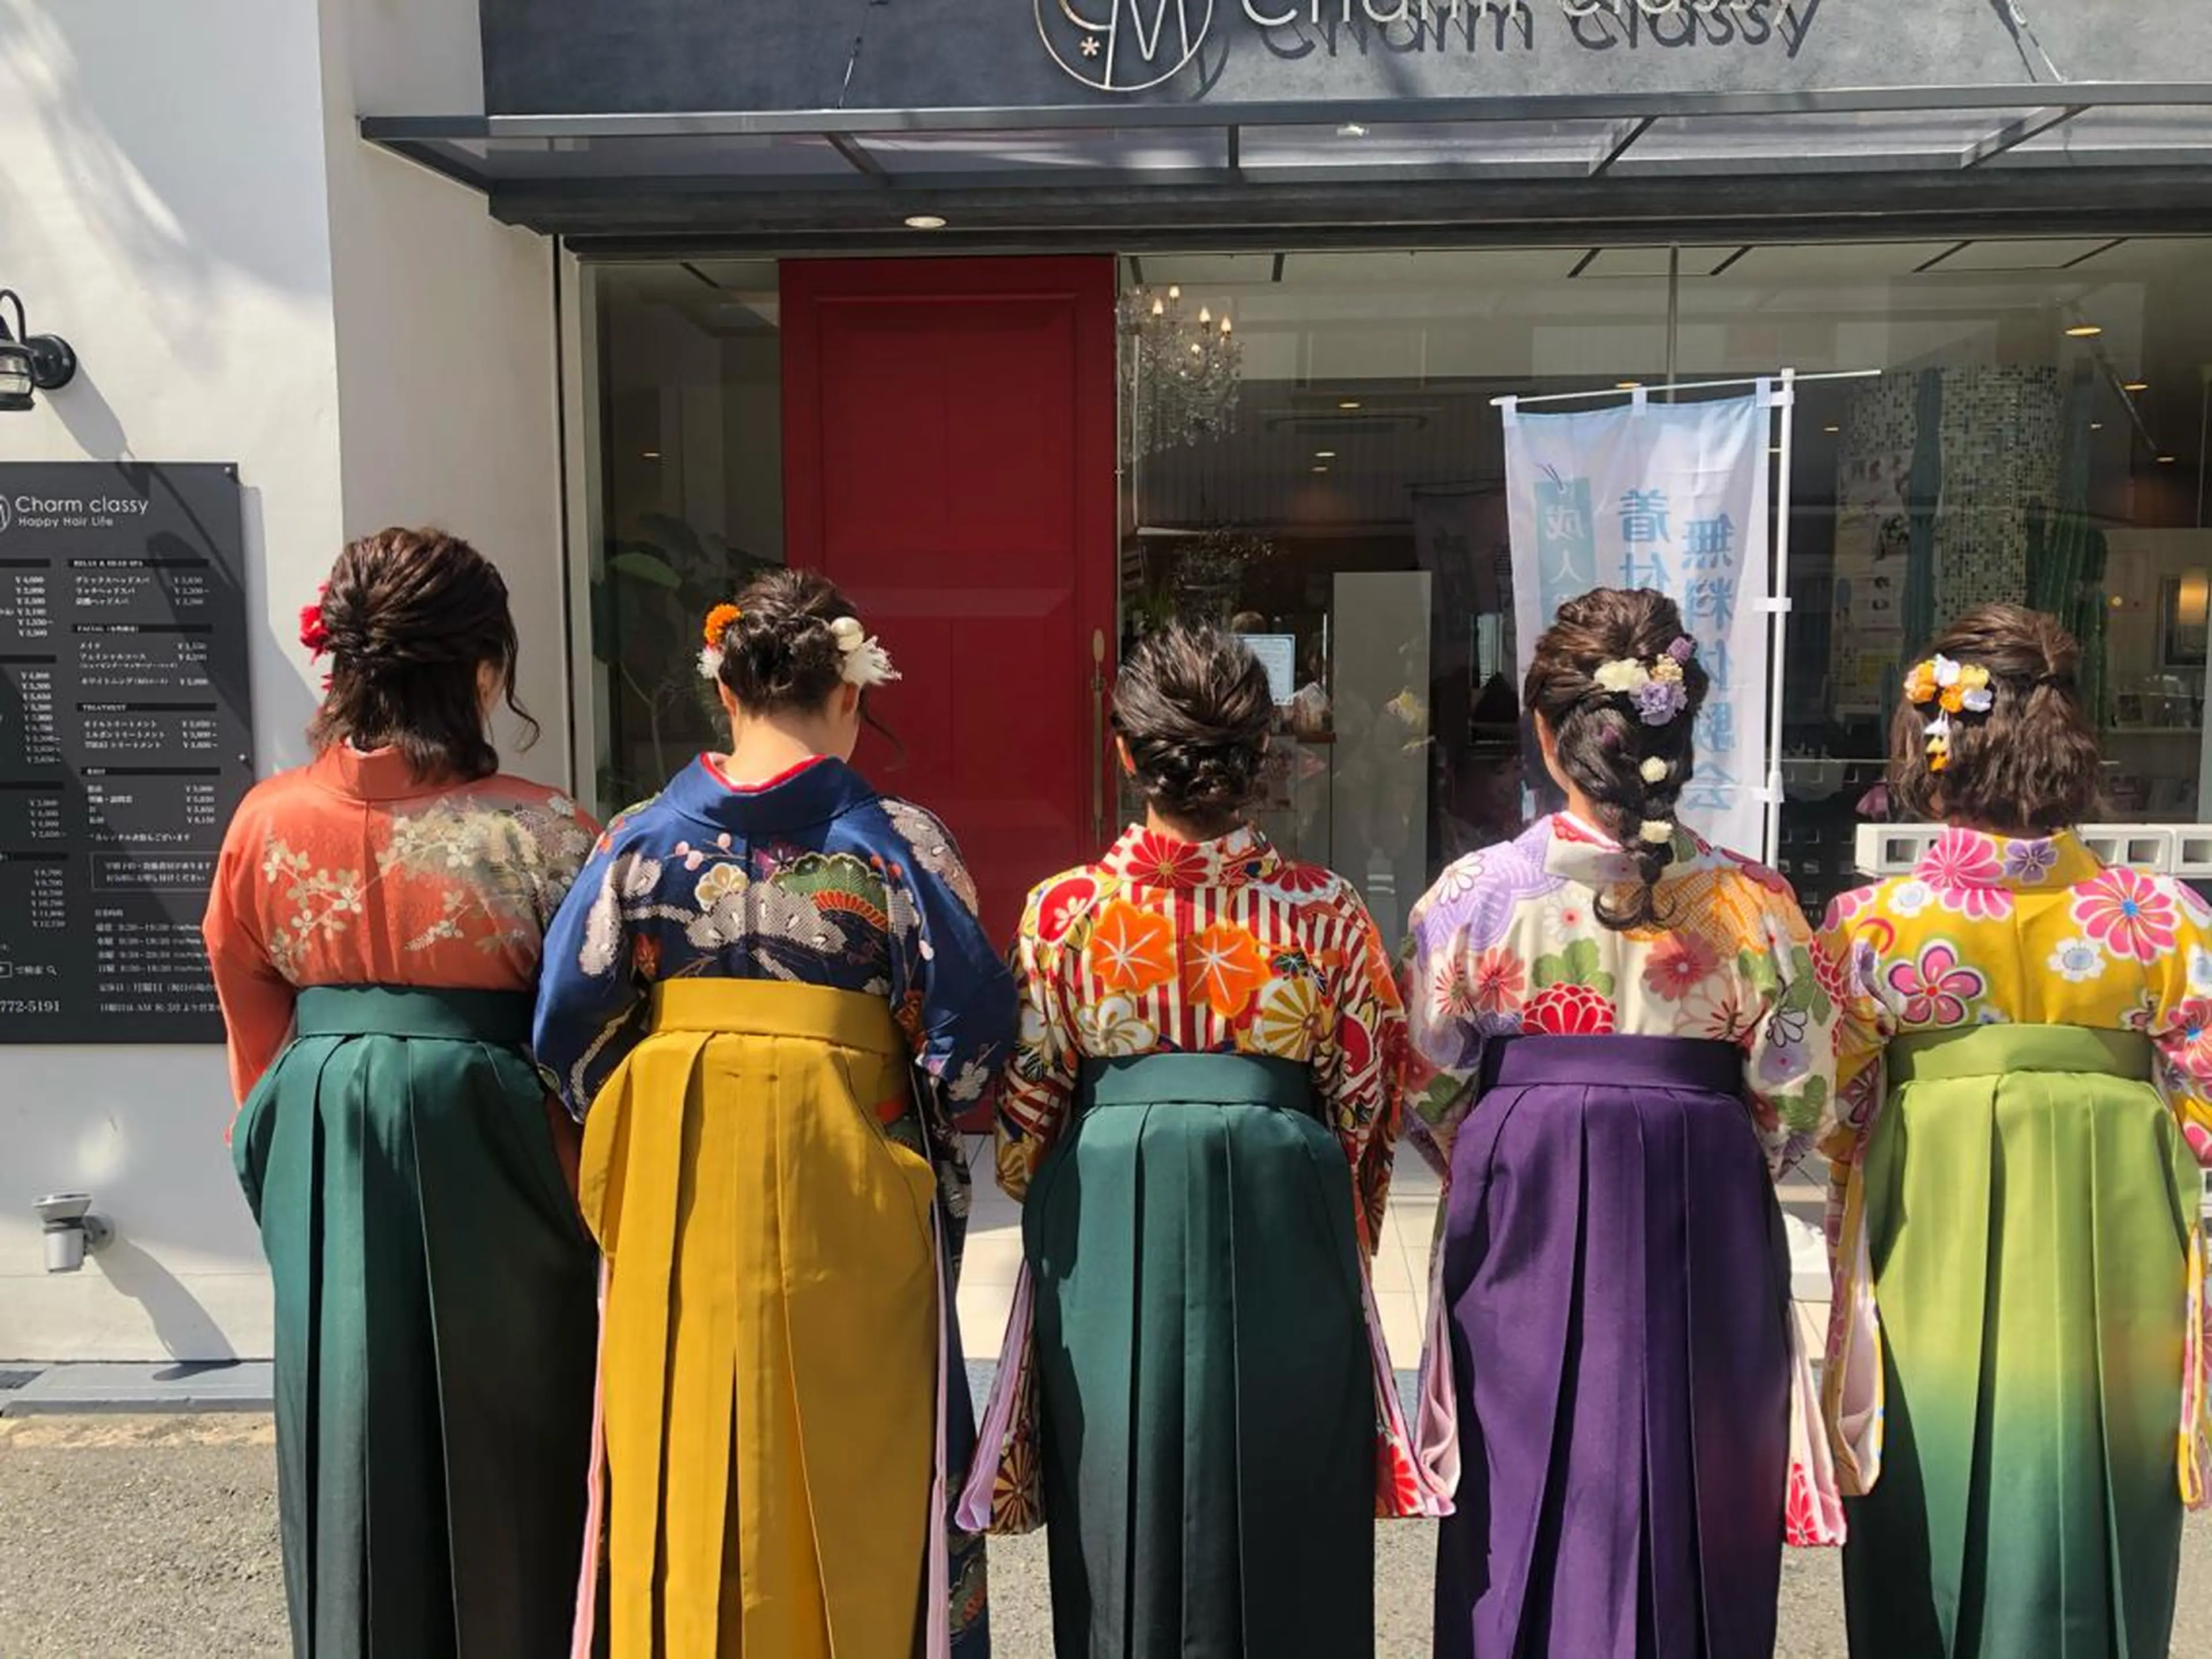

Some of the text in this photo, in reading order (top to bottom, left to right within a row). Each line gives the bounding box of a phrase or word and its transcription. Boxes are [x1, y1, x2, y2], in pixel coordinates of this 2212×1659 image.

[15, 495, 82, 513] Charm
[89, 494, 148, 514] classy
[18, 516, 113, 528] Happy Hair Life
